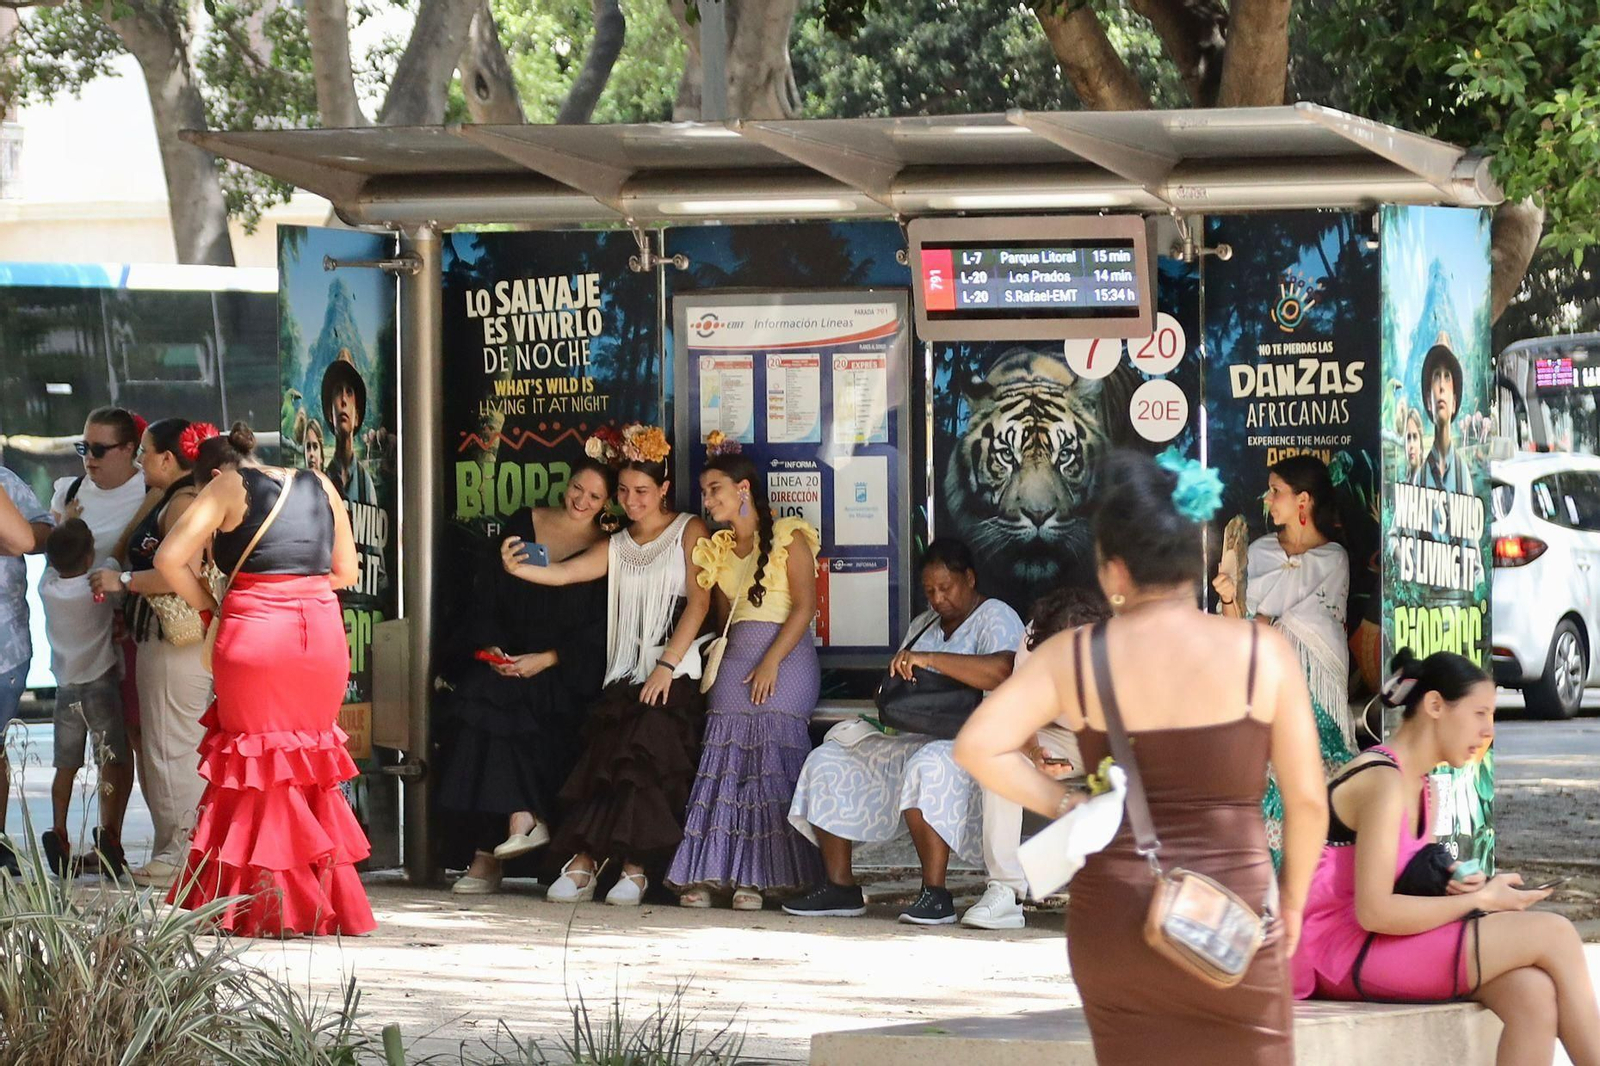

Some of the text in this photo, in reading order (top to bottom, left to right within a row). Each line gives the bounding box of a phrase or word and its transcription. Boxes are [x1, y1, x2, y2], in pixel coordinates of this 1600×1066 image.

[963, 250, 1130, 266] L-7 Parque Litoral 15 min
[930, 270, 943, 290] 791
[961, 269, 1132, 284] L-20 Los Prados 14 min
[465, 273, 601, 318] LO SALVAJE
[963, 288, 1135, 303] L-20 S.Rafael-EMT 15:34 h
[483, 308, 602, 345] ES VIVIRLO
[754, 317, 853, 329] Información Líneas
[1136, 328, 1177, 358] 20
[1259, 341, 1333, 356] NO TE PIERDAS LAS
[483, 339, 591, 374] DE NOCHE
[494, 377, 594, 396] WHAT'S WILD IS
[1229, 358, 1365, 398] DANZAS
[479, 395, 609, 416] LIVING IT AT NIGHT
[1138, 400, 1180, 420] 20E
[1246, 399, 1349, 428] AFRICANAS
[1247, 435, 1351, 446] EXPERIENCE THE MAGIC OF
[784, 460, 818, 468] INFORMA
[770, 472, 819, 487] LÍNEA 20
[770, 488, 818, 502] DIRECCIÓN
[1394, 483, 1484, 541] WHAT'S WILD
[352, 501, 388, 549] WILD
[1400, 536, 1476, 592] IS LIVING IT
[366, 554, 380, 596] IT
